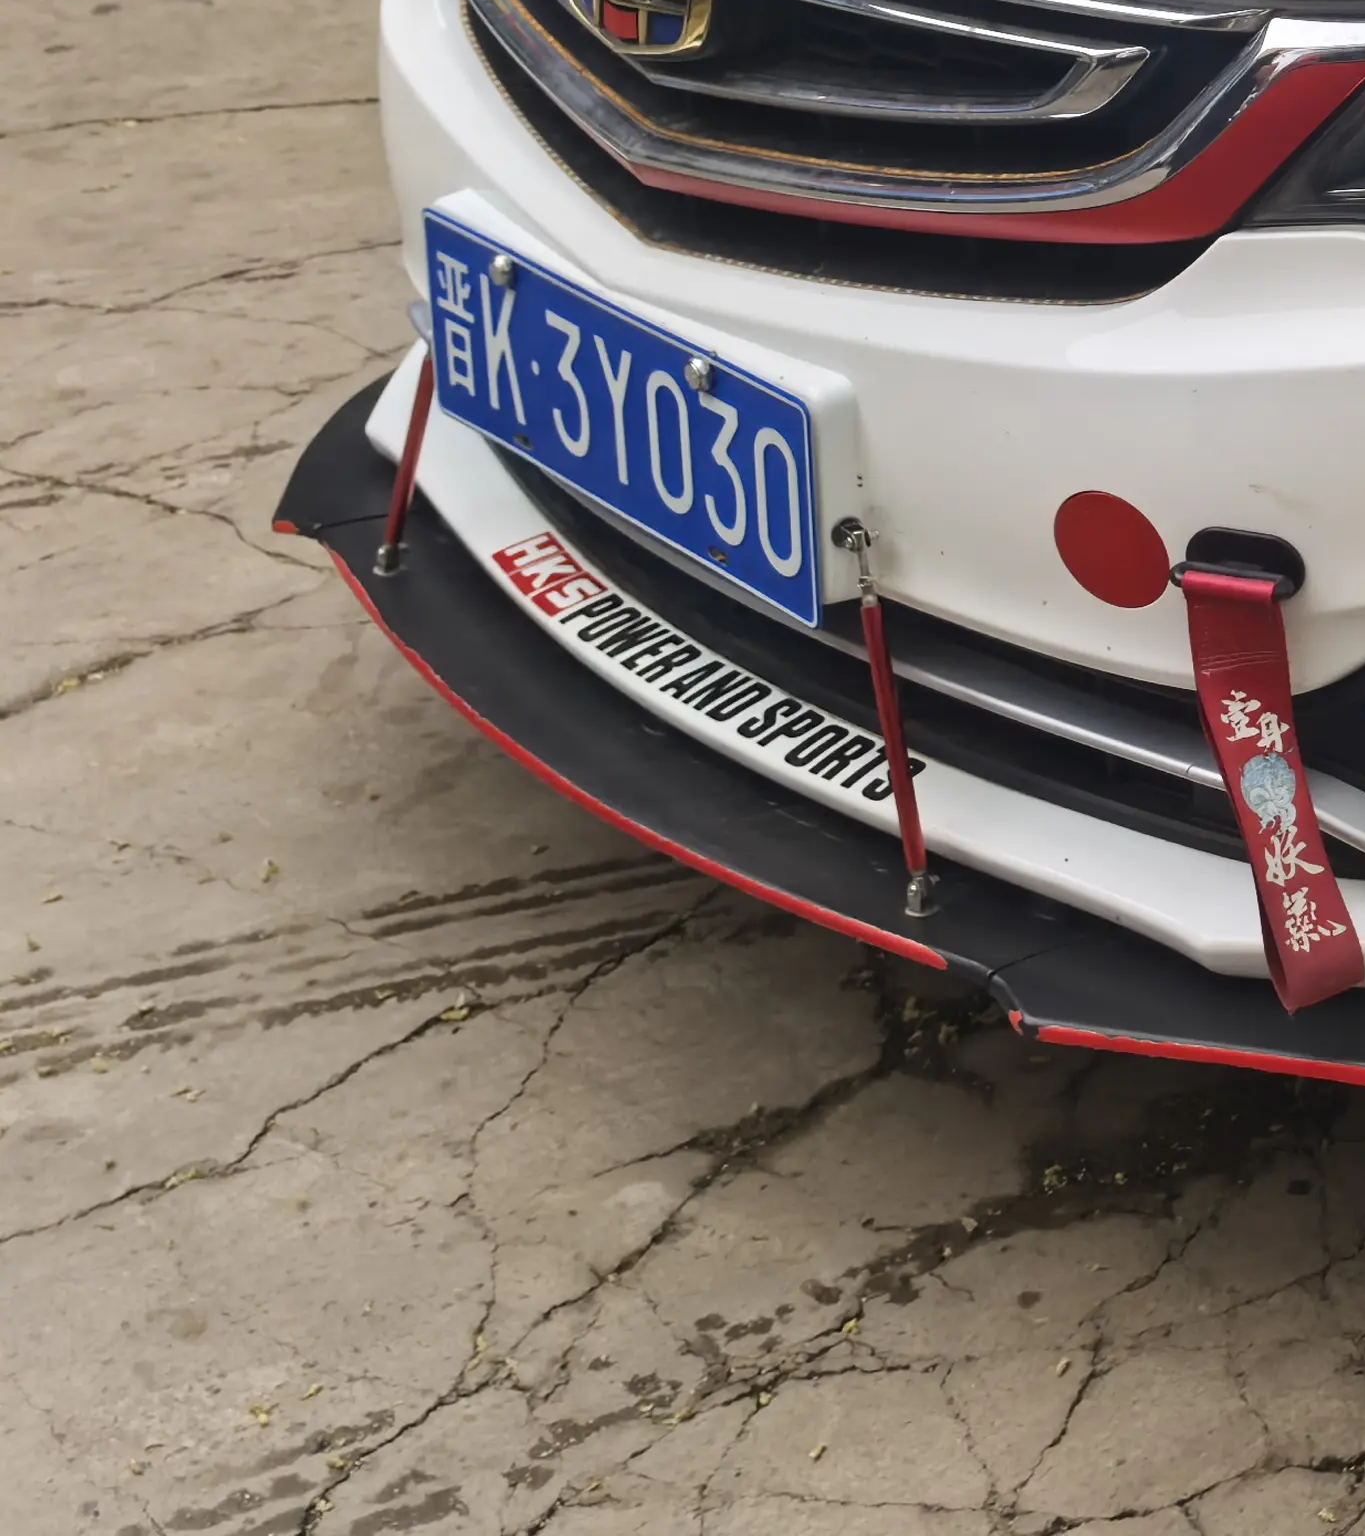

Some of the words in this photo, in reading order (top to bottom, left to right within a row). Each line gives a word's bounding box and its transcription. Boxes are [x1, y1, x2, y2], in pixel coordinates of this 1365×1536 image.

[436, 250, 803, 578] 晋K·3Y030
[502, 533, 604, 611] HKS
[559, 593, 703, 684] POWER
[658, 660, 773, 723] AND
[736, 697, 927, 801] SPORTS
